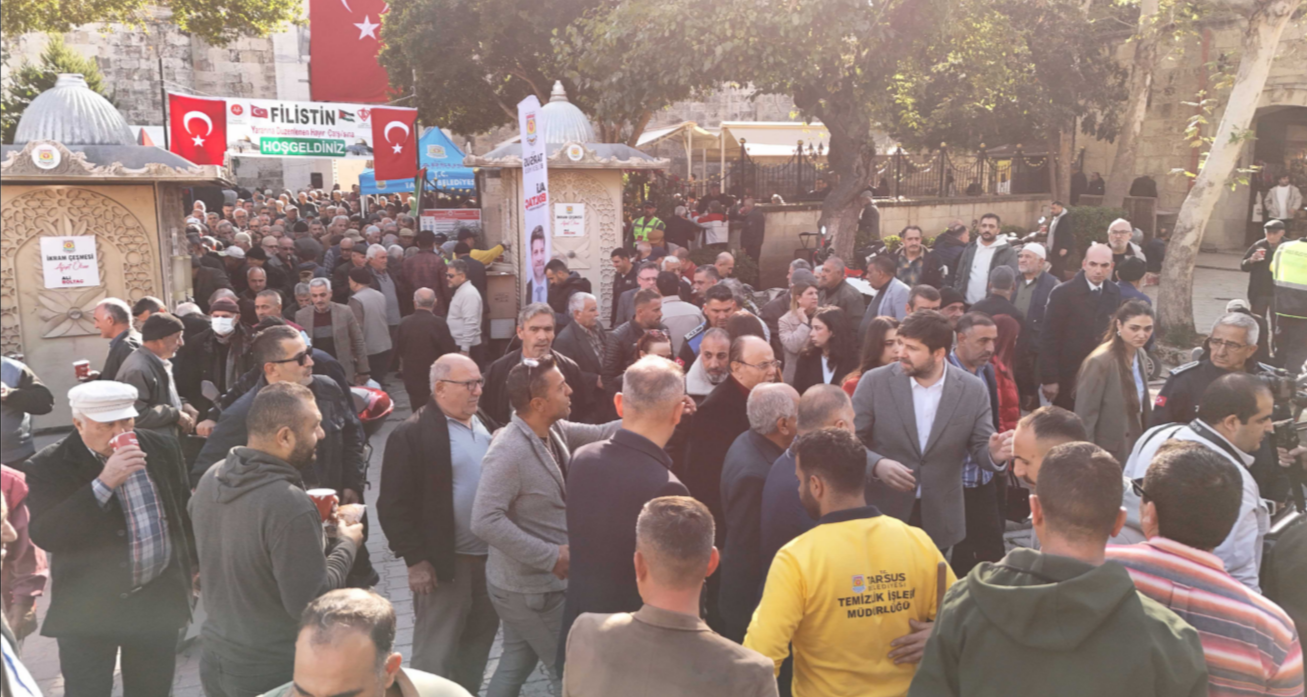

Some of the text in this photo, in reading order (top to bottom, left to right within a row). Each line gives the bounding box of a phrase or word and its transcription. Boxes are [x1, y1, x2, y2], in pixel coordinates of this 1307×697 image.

[270, 103, 336, 126] FİLİSTİN
[262, 140, 345, 155] HOŞGELDİNİZ
[437, 178, 474, 187] BELEDİYES
[867, 572, 906, 584] TARSUS
